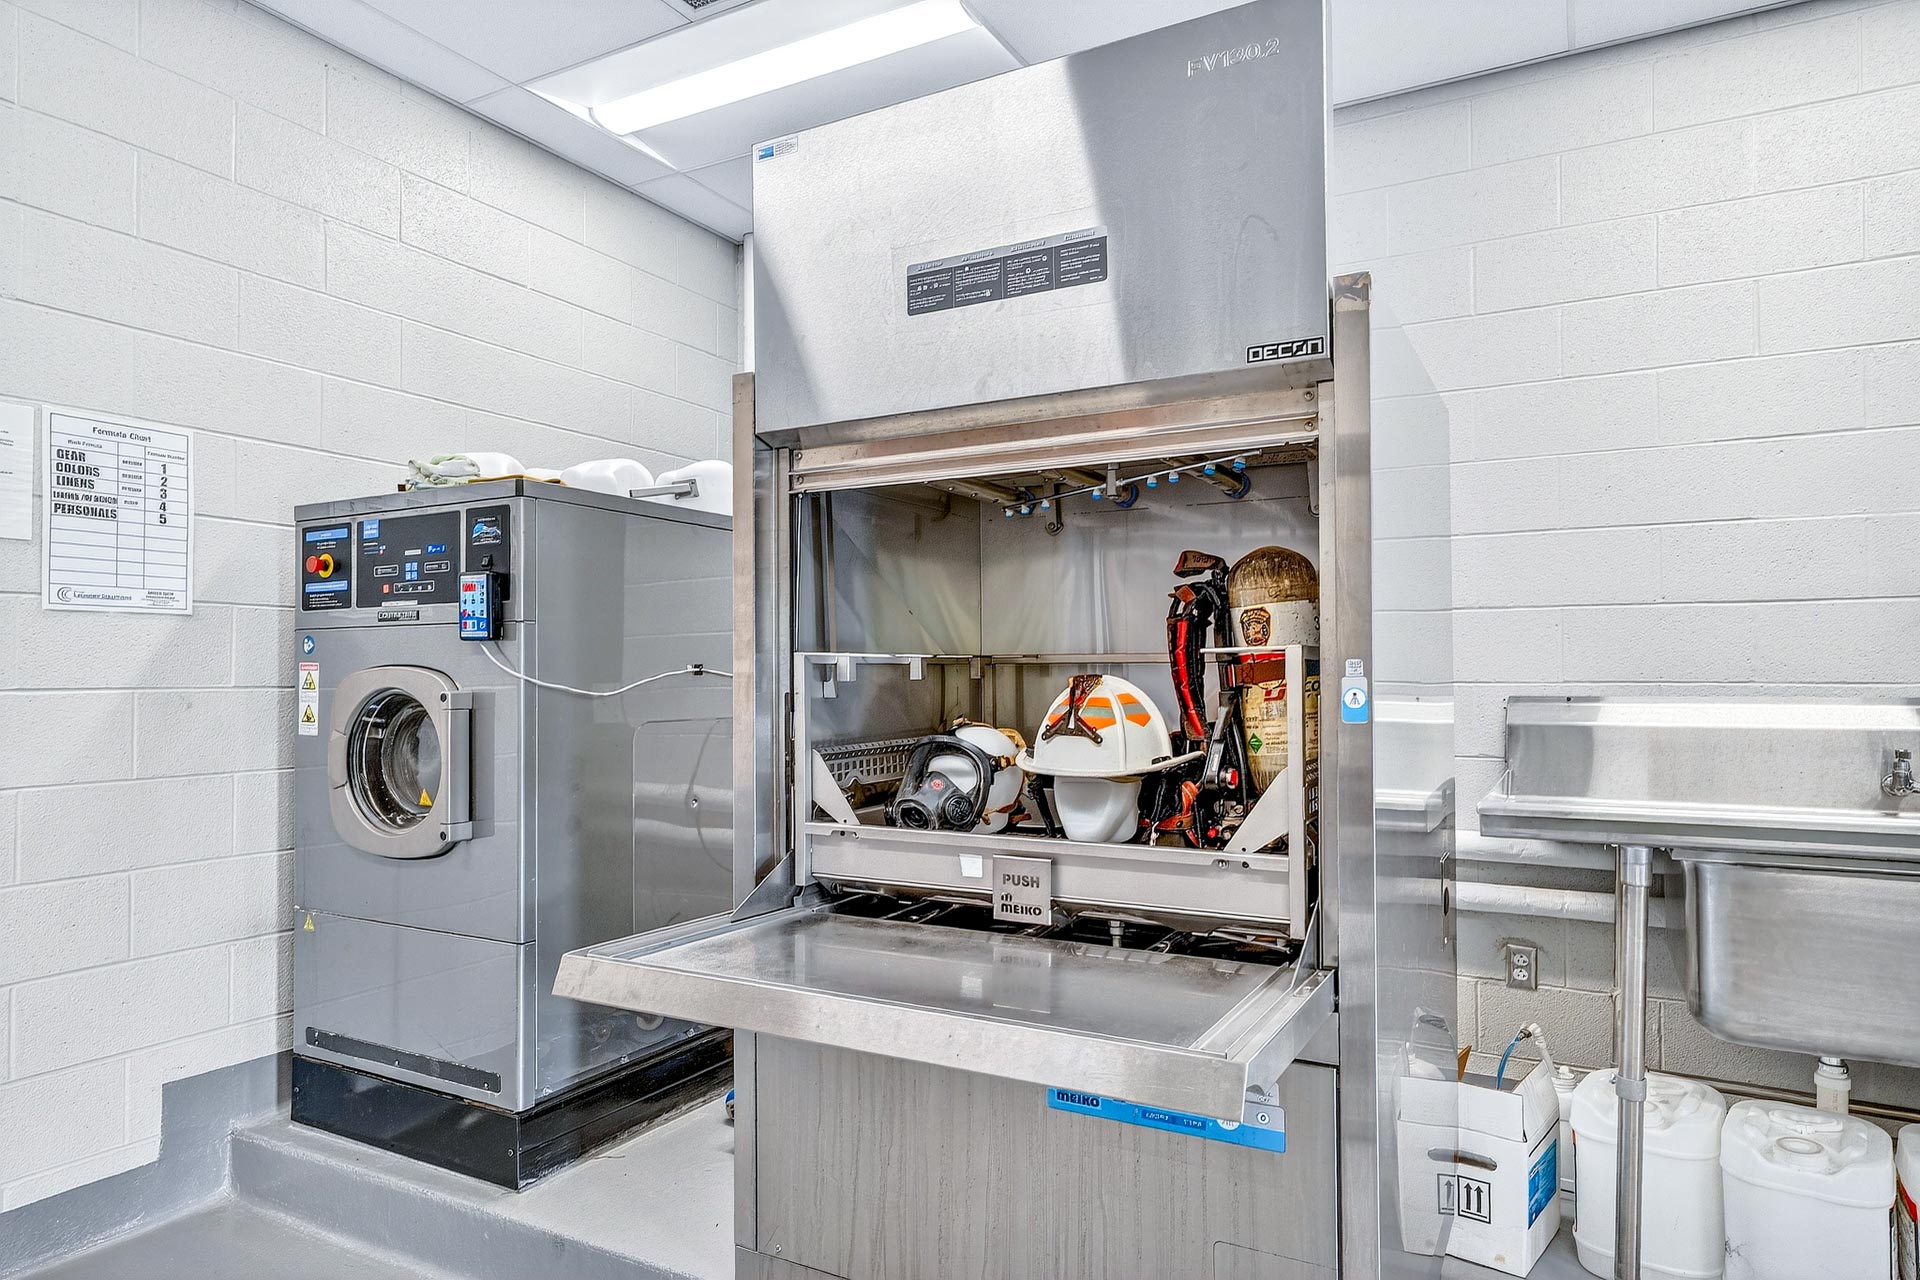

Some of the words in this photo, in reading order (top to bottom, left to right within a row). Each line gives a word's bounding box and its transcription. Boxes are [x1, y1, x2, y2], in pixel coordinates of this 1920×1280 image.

[1186, 37, 1280, 78] FV130.2
[1248, 338, 1323, 362] DECON
[92, 426, 127, 439] Formula
[129, 431, 151, 443] Chart
[56, 448, 86, 462] GEAR
[56, 461, 100, 478] COLORS
[160, 464, 167, 475] 1
[56, 475, 95, 490] LINENS
[160, 477, 168, 487] 2
[160, 488, 168, 499] 3
[53, 502, 117, 520] PERSONALS
[159, 501, 167, 512] 4
[159, 513, 167, 524] 5
[1002, 873, 1040, 889] PUSH
[1001, 903, 1042, 917] MEIKO
